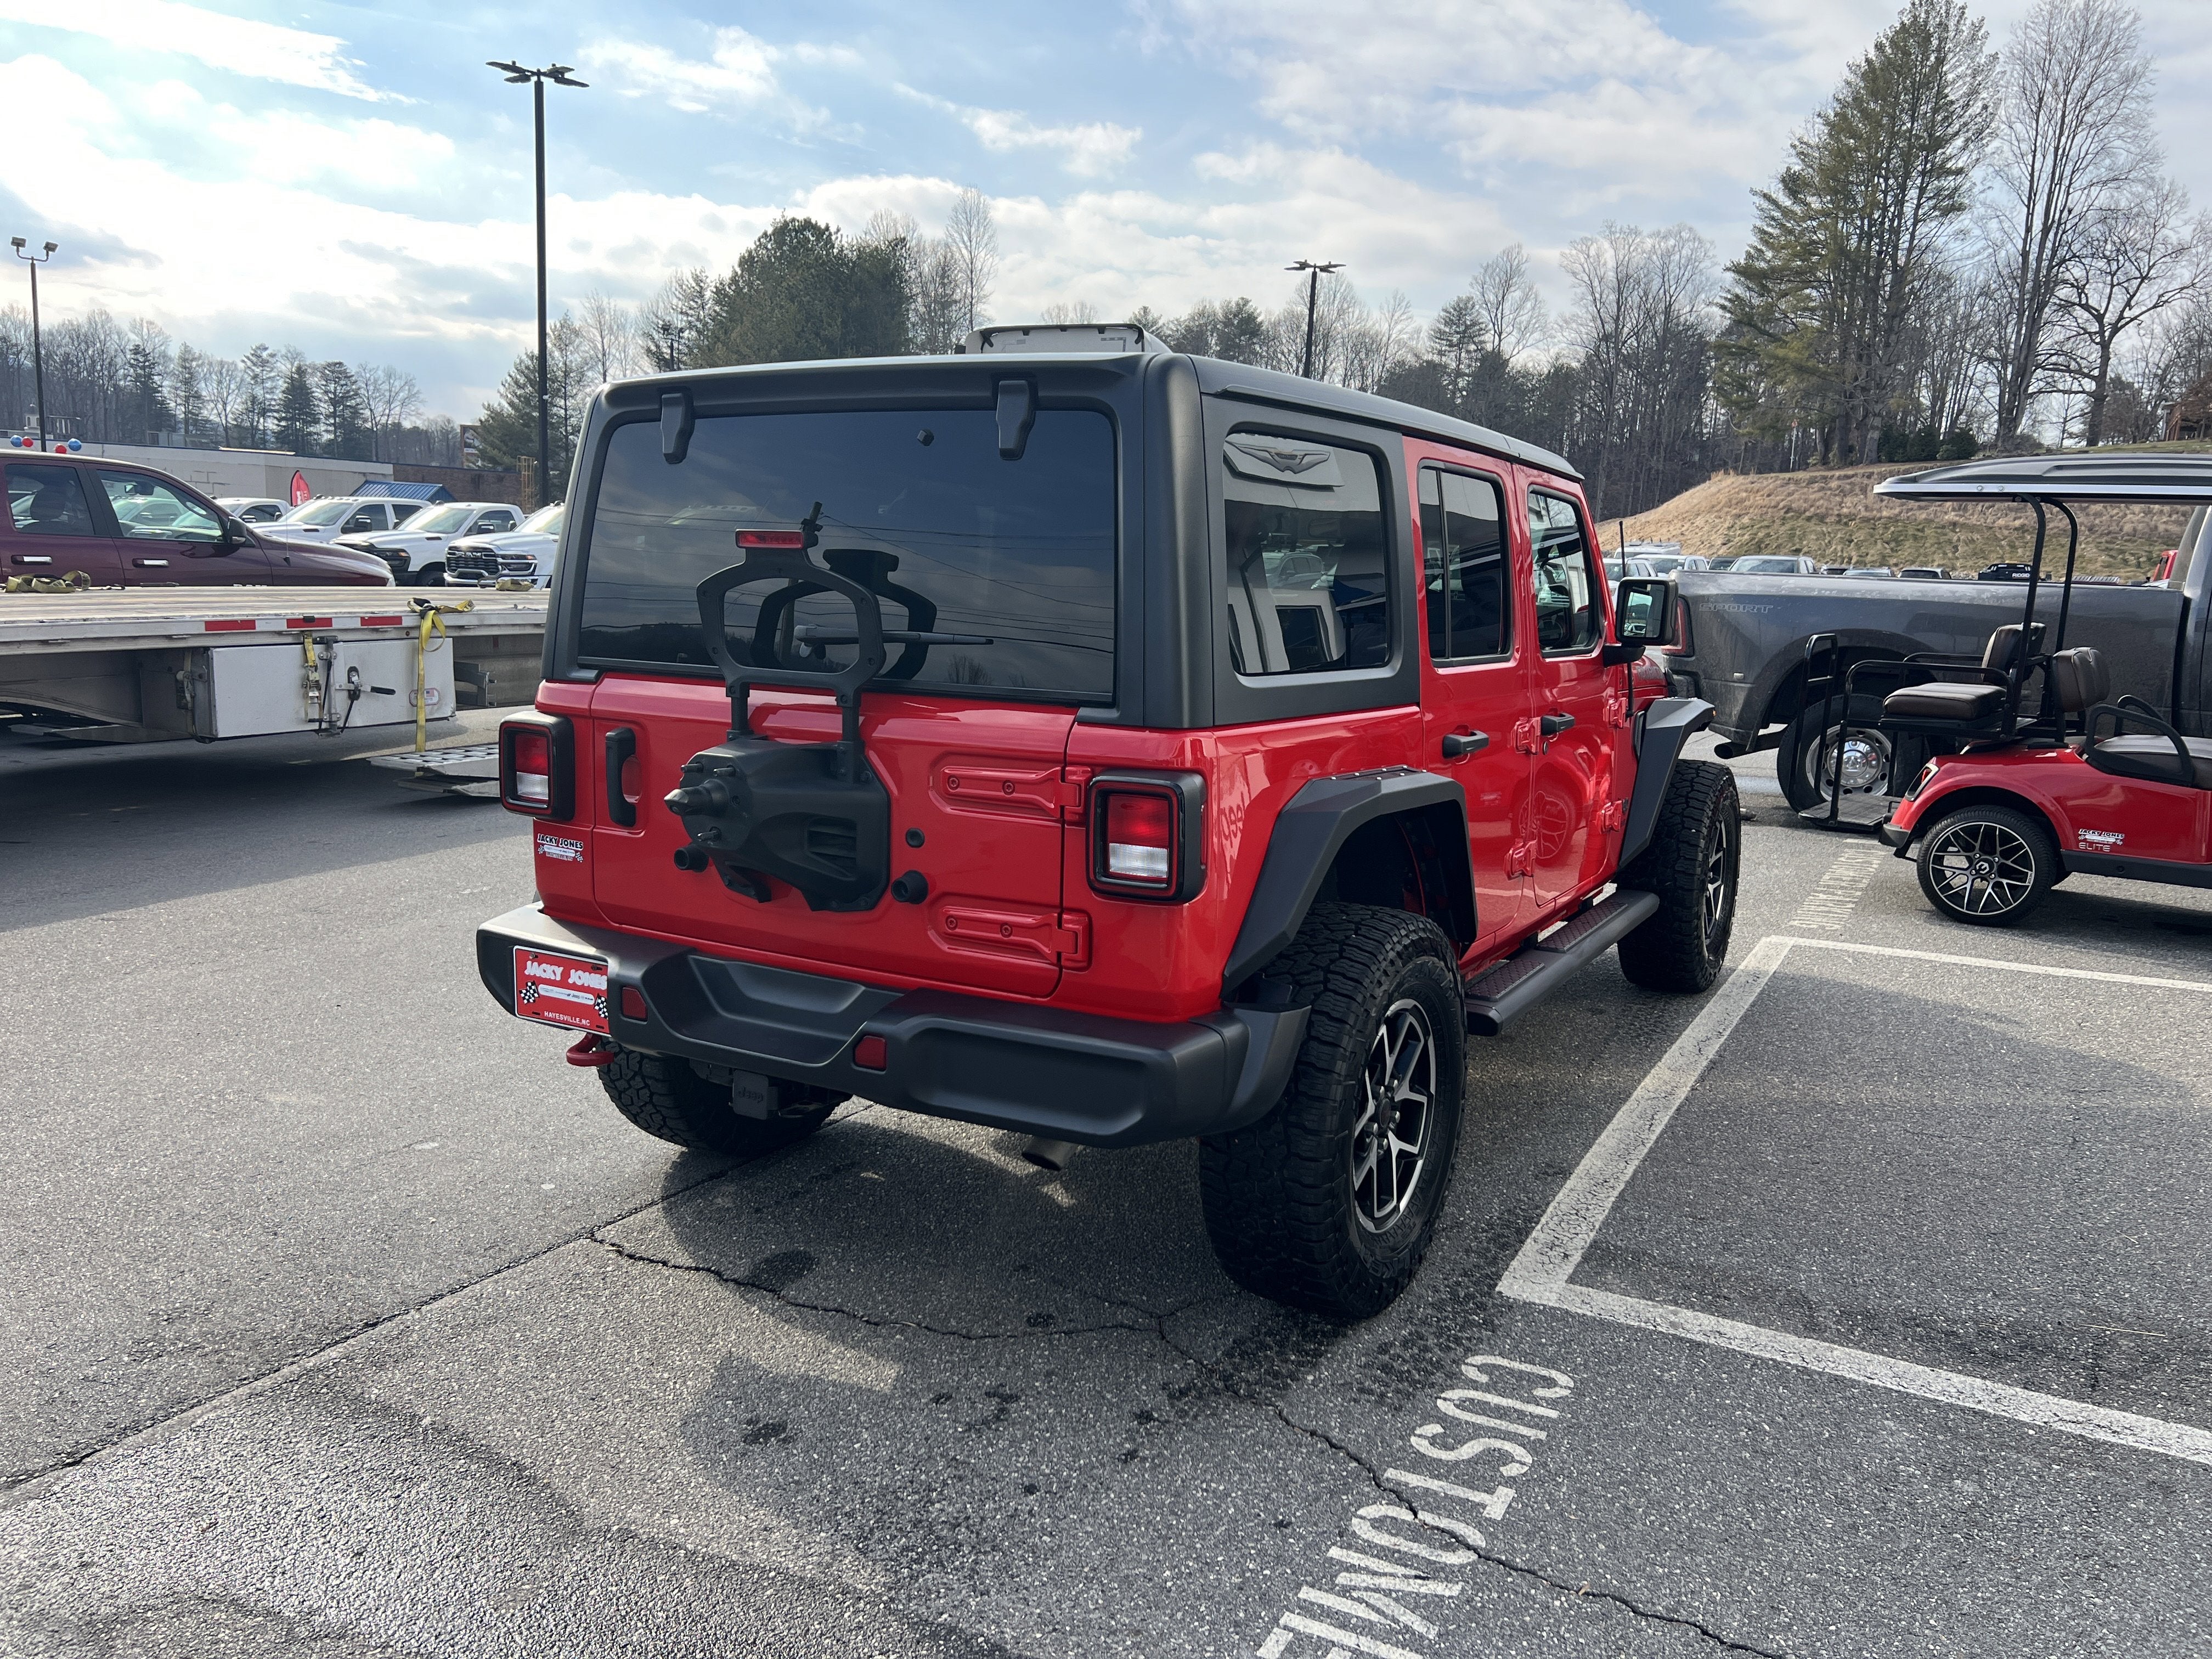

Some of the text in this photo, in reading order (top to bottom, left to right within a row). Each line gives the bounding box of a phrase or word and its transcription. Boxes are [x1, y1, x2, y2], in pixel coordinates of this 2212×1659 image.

[1699, 603, 1774, 613] SPORT
[537, 833, 584, 850] JACKY JONES
[2079, 842, 2111, 852] ELITE
[524, 960, 607, 990] JACKY JONES
